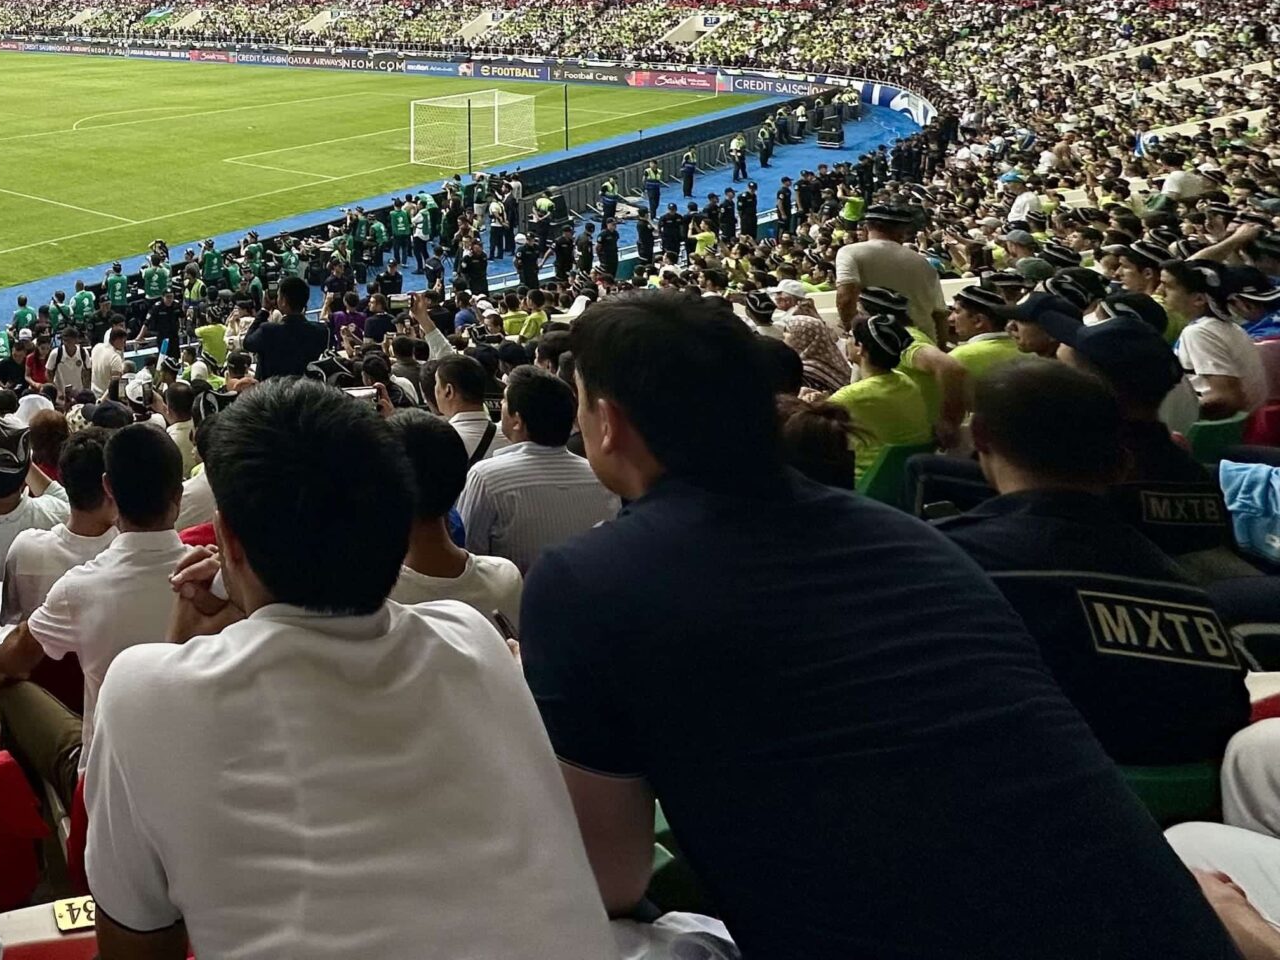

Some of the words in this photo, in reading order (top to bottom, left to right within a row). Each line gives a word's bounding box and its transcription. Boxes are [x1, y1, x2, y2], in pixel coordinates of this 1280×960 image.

[238, 54, 260, 62] CREDIT
[261, 55, 287, 64] SAISON
[288, 57, 310, 66] QATAR
[313, 58, 342, 67] AIRWAYS
[343, 60, 404, 71] NEOM.COM
[564, 71, 593, 80] Football
[595, 72, 618, 81] Cares
[735, 79, 773, 90] CREDIT
[775, 83, 810, 96] SAISON
[1150, 497, 1219, 519] MXTB
[1093, 603, 1227, 657] MXTB
[65, 900, 95, 925] 34
